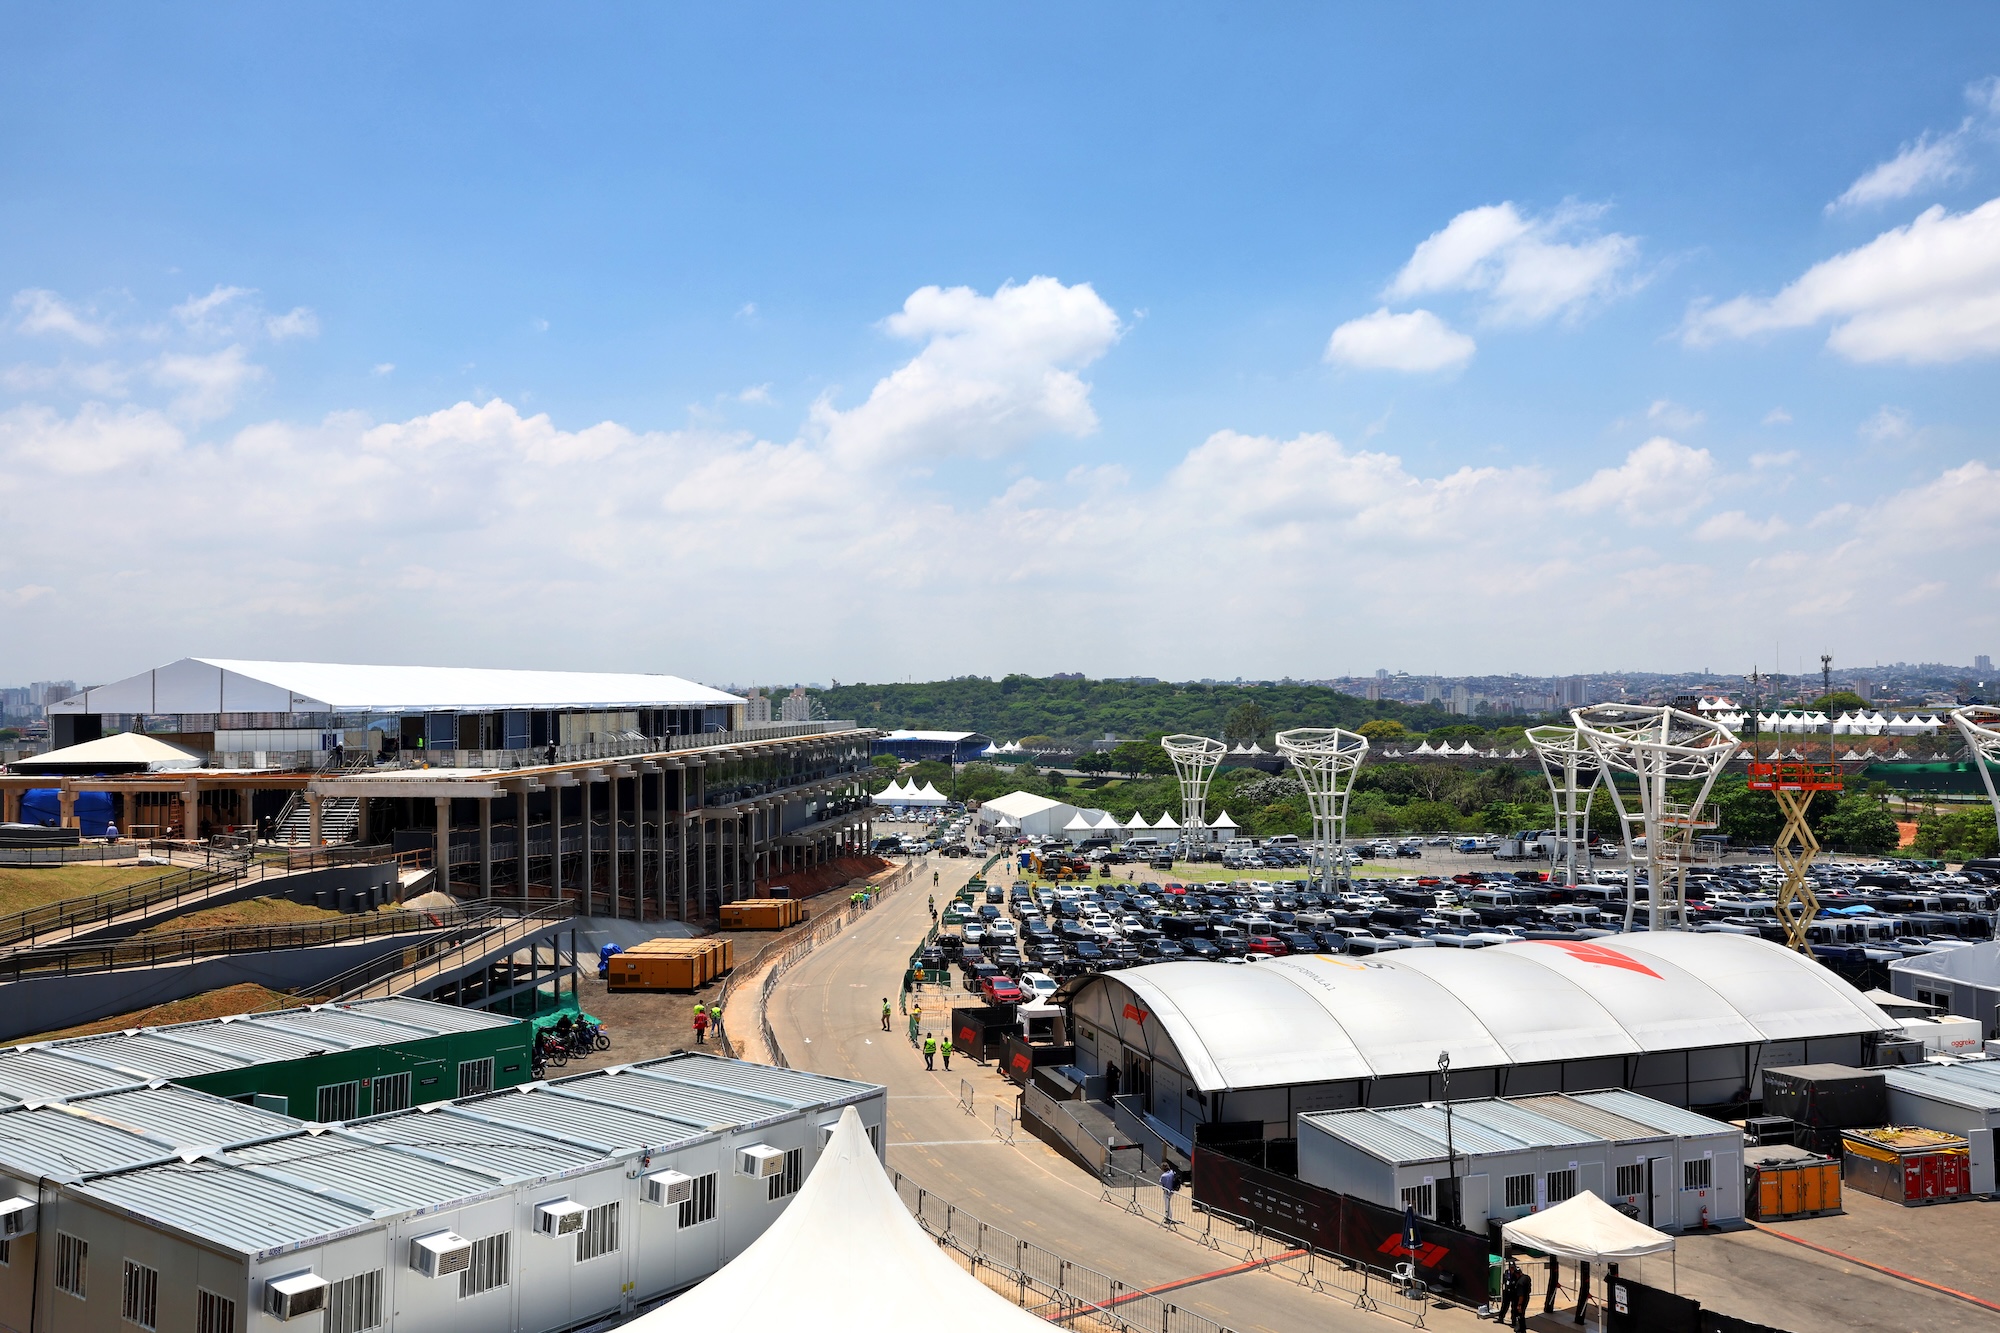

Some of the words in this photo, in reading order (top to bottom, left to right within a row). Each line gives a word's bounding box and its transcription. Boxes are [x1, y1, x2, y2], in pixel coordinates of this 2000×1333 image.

[1298, 967, 1331, 988] FORMULA
[1122, 1003, 1149, 1026] F1
[959, 1026, 977, 1045] F1
[1012, 1052, 1031, 1073] F1
